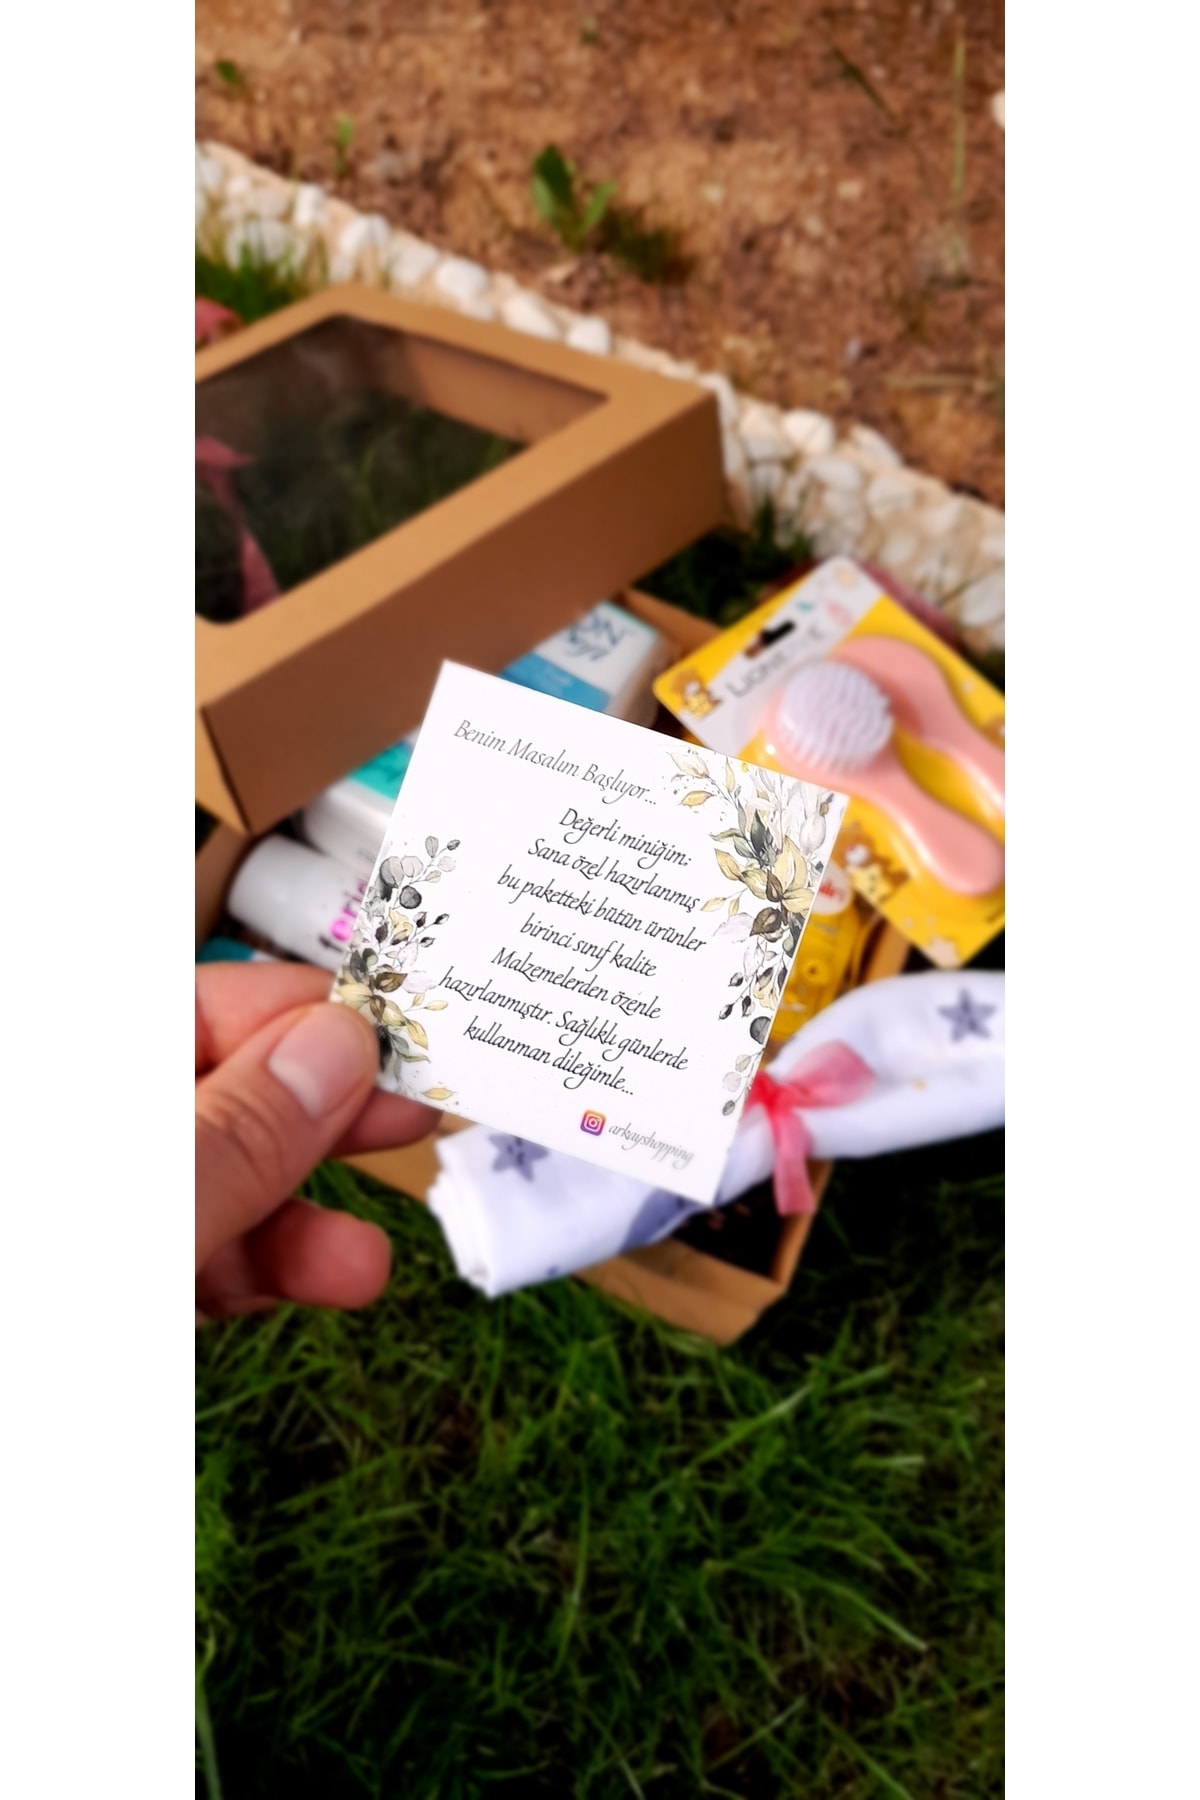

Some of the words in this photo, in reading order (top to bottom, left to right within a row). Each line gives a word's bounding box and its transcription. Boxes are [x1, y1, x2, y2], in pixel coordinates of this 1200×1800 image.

[454, 720, 506, 751] Benim
[507, 739, 579, 776] Masalım
[581, 764, 656, 804] Başlıyor...
[559, 808, 622, 845] Değerli
[620, 834, 692, 869] miniğim:
[497, 864, 520, 889] bu
[508, 879, 596, 915] paketteki
[528, 838, 570, 866] Sana
[572, 856, 609, 880] özel
[604, 863, 700, 913] hazırlanmış
[520, 912, 576, 948] birinci
[573, 940, 617, 972] sınıf
[611, 941, 657, 976] kalite
[593, 898, 642, 931] bütün
[644, 921, 707, 951] ürünler
[490, 947, 608, 1001] Malzemelerden
[611, 991, 661, 1018] özenle
[438, 966, 553, 1024] hazırlanmıştır.
[555, 1011, 618, 1047] Sağlıklı
[602, 1038, 689, 1070] günlerde
[463, 1016, 550, 1064] kullanman
[552, 1049, 633, 1095] dileğimle...
[608, 1123, 693, 1168] arkayshopping
